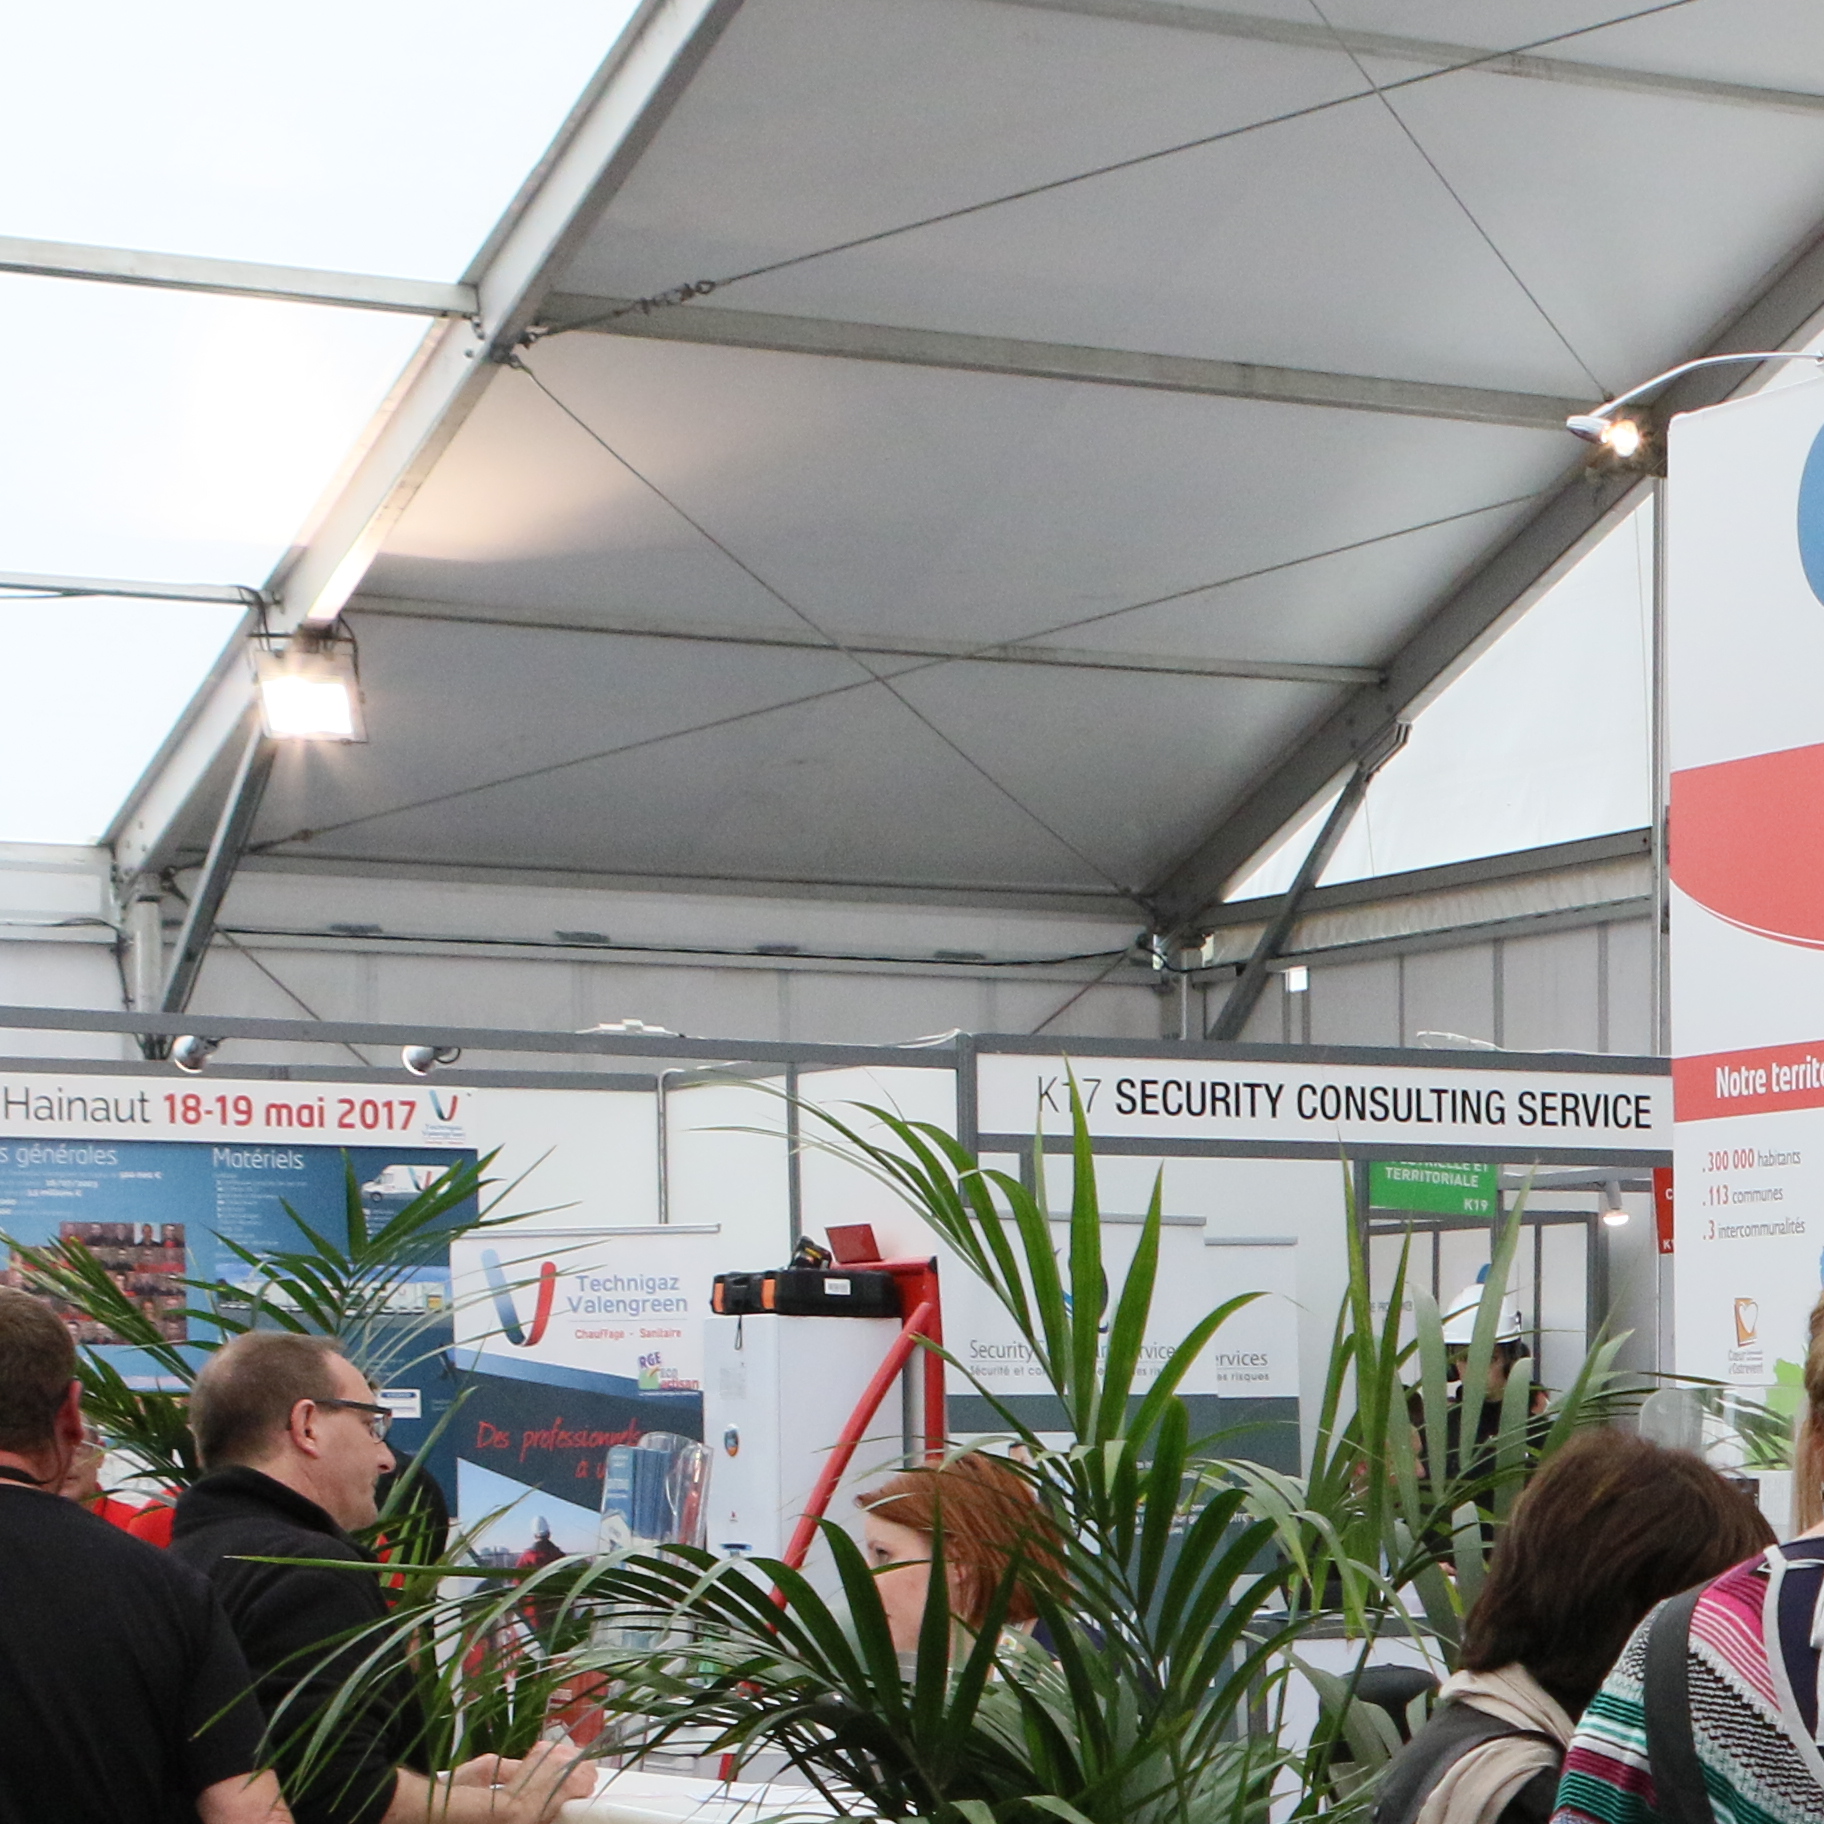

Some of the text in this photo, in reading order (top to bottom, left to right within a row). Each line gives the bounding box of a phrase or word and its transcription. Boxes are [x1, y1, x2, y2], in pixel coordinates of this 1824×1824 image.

[1716, 1066, 1767, 1099] Notre
[4, 1086, 416, 1131] Hainaut 18-19 mai 2017
[1115, 1078, 1285, 1120] SECURITY
[1297, 1085, 1506, 1126] CONSULTING
[1518, 1091, 1653, 1130] SERVICE
[16, 1143, 118, 1168] générales
[213, 1146, 304, 1170] Matériels
[1757, 1147, 1801, 1168] habitants
[1385, 1166, 1479, 1188] TERRITORIALE
[1463, 1198, 1489, 1212] K19
[1732, 1187, 1783, 1204] communes
[1718, 1216, 1805, 1239] intercommunalités
[576, 1274, 680, 1294] Technigaz
[567, 1296, 688, 1318] Valengreen
[575, 1329, 625, 1340] Chauffage
[639, 1328, 682, 1338] Sanitaire
[970, 1339, 1033, 1366] Security
